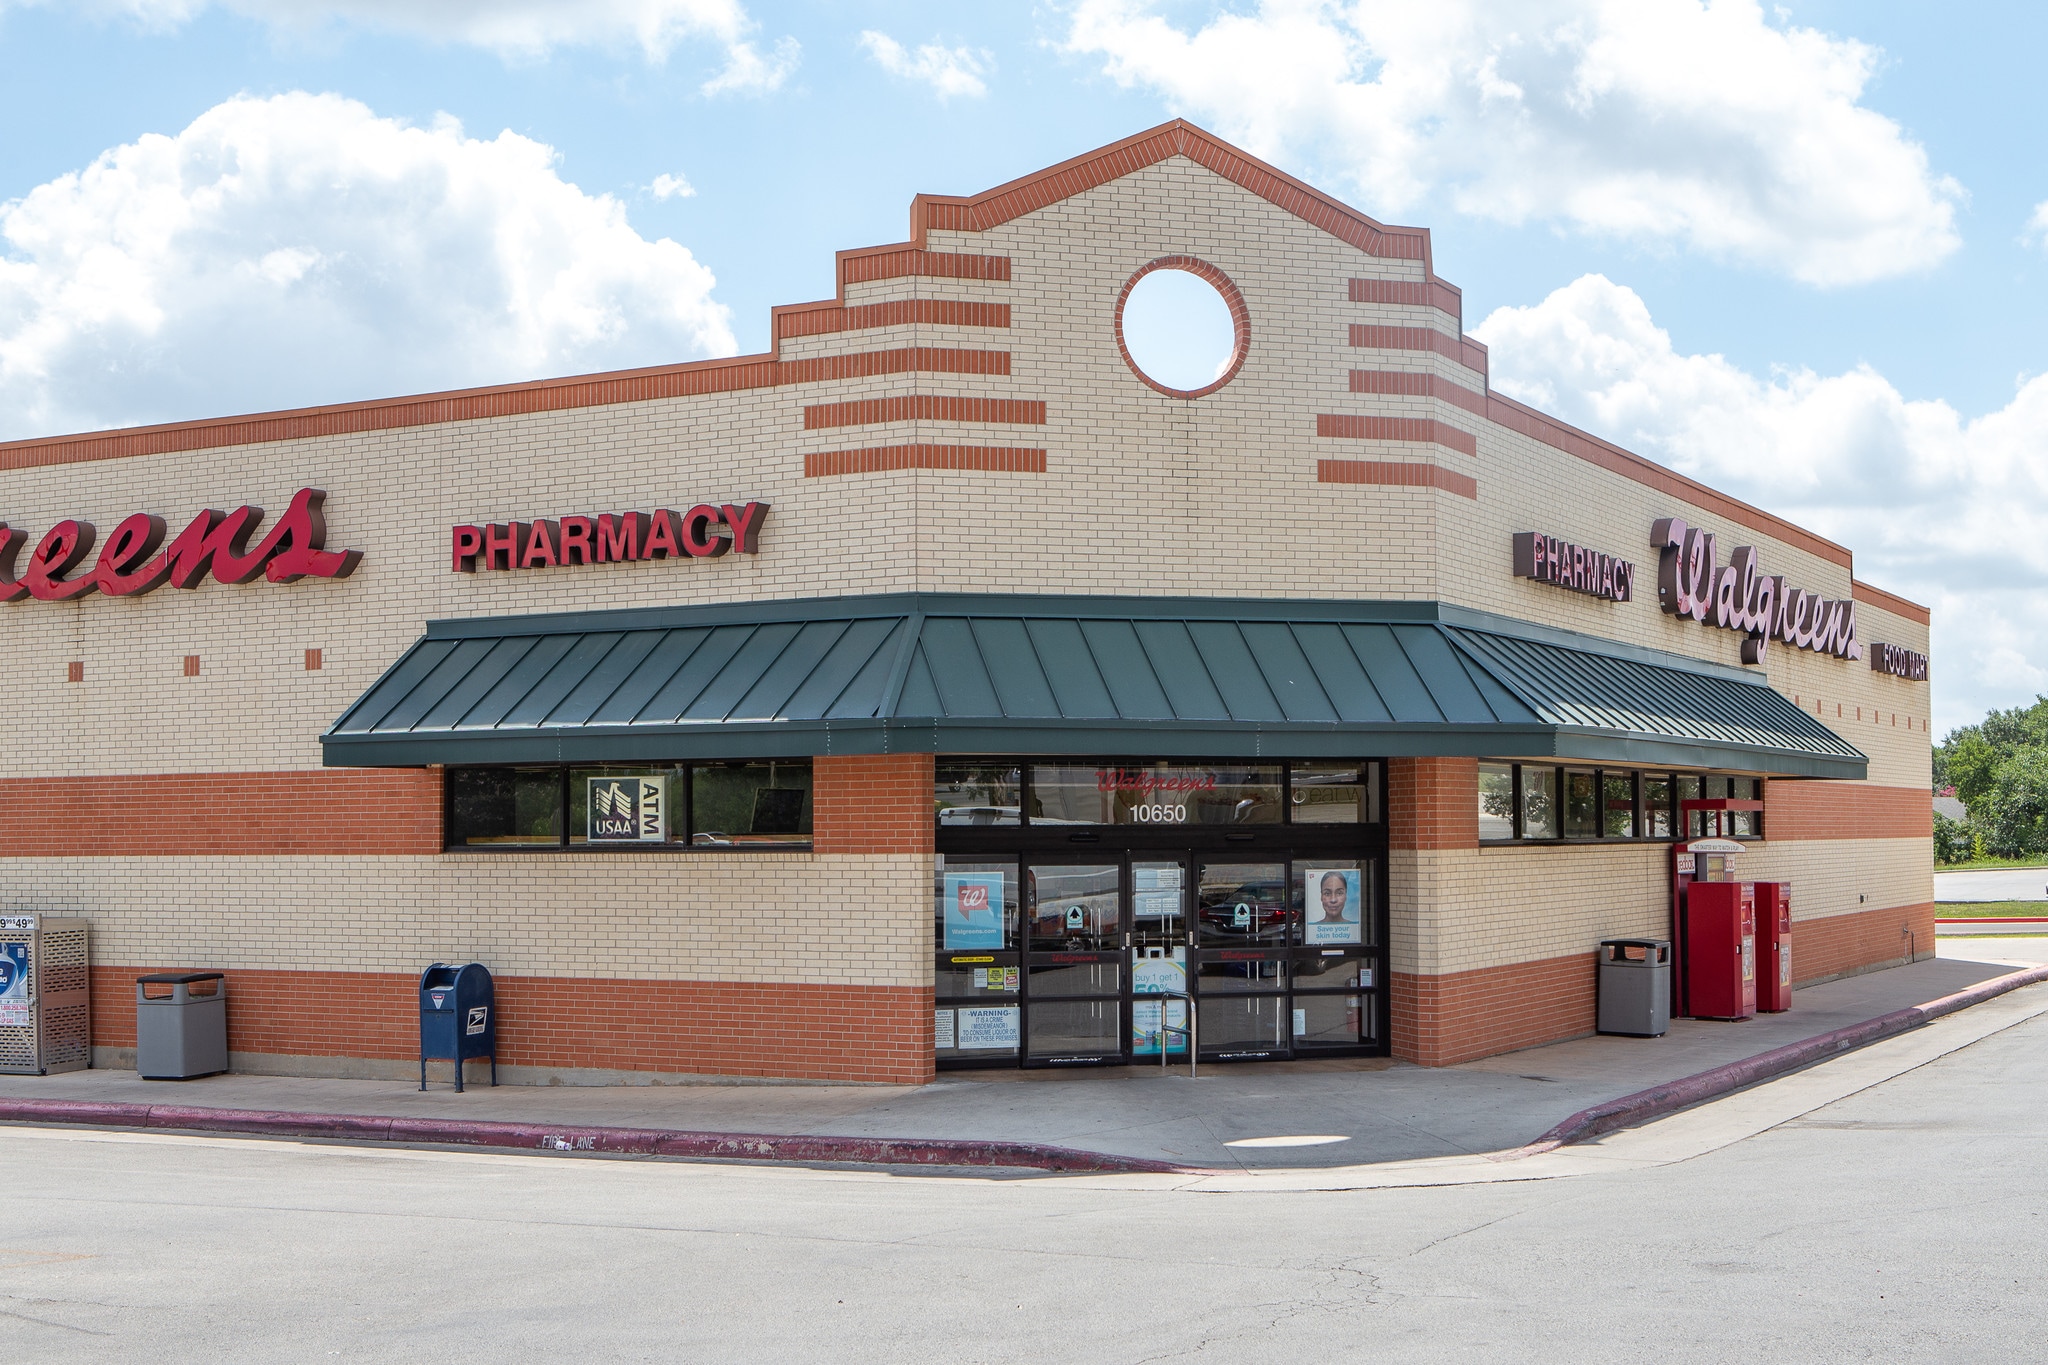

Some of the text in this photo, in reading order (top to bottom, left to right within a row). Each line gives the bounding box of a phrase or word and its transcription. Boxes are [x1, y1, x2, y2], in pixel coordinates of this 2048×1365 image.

[452, 502, 768, 573] PHARMACY
[1524, 531, 1636, 602] PHARMACY
[1655, 517, 1864, 664] Walgreens
[1881, 642, 1929, 681] FOOD MART
[1095, 768, 1217, 798] Walgreens
[643, 783, 659, 835] ATM
[1129, 804, 1187, 822] 10650
[596, 820, 632, 835] USAA
[1678, 855, 1695, 870] redbox
[951, 928, 997, 936] Walgreens.com
[1135, 974, 1151, 983] buy
[1159, 974, 1173, 982] get
